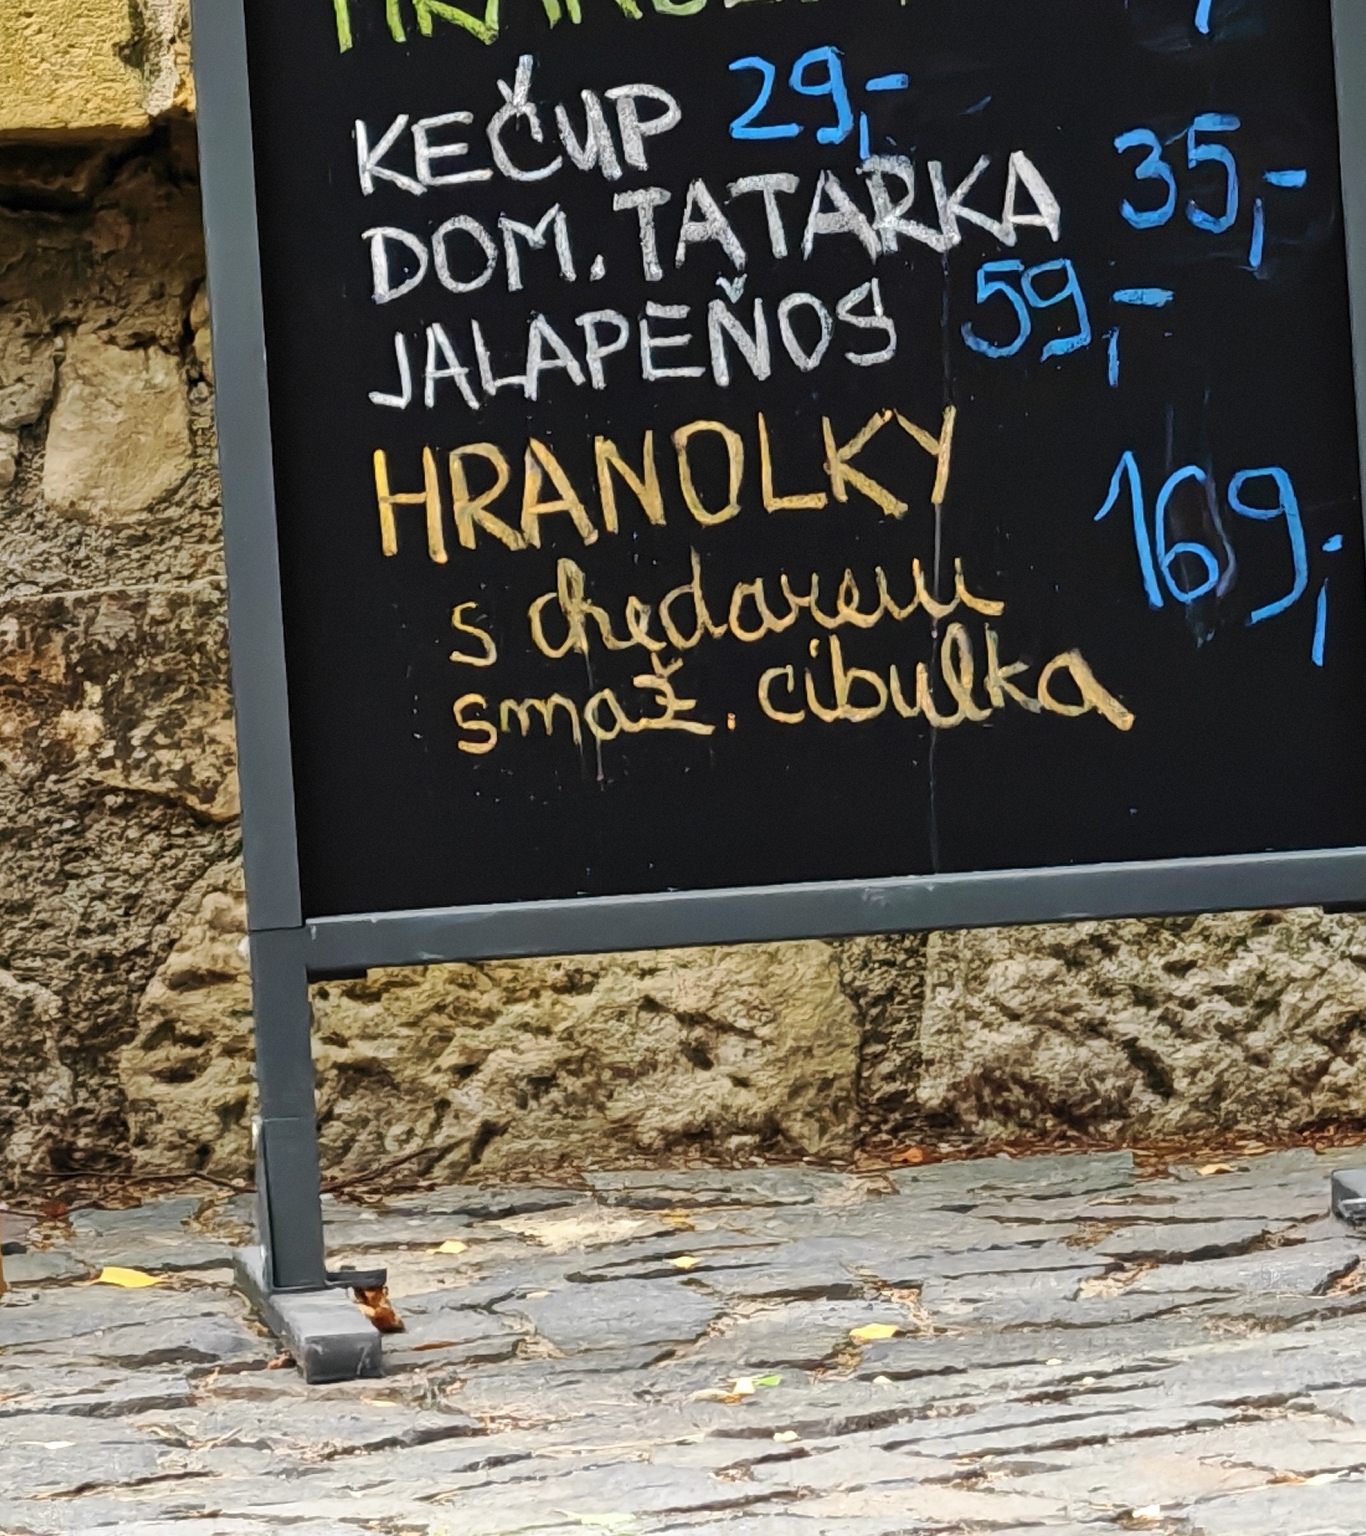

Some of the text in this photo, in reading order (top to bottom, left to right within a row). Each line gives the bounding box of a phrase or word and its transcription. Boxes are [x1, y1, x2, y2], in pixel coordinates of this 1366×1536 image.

[354, 52, 682, 196] KEČUP
[360, 203, 606, 305] DOM.
[612, 150, 1062, 282] TATARKA
[371, 405, 958, 564] HRANOLKY
[449, 601, 497, 667] s
[758, 623, 1135, 733] cibulka
